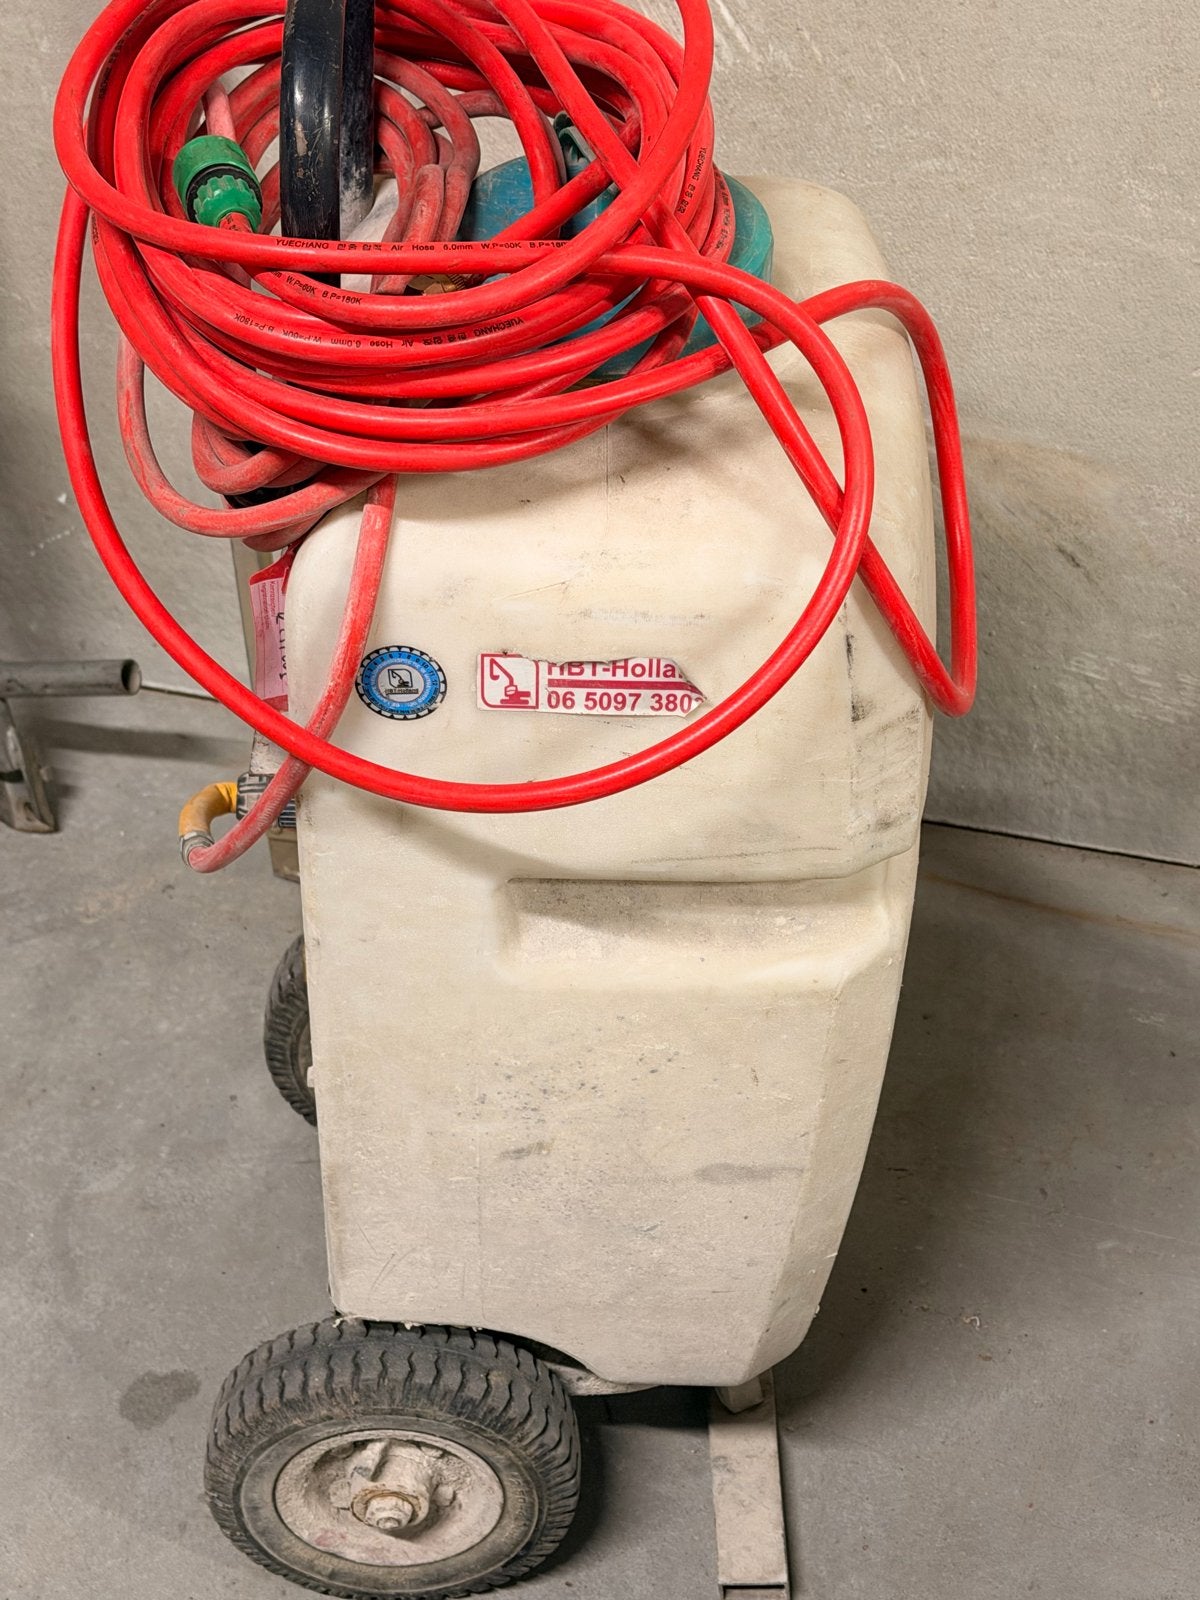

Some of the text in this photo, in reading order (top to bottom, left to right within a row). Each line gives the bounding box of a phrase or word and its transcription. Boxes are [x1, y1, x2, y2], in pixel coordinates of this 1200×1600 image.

[275, 238, 329, 250] YUECHANG
[390, 244, 404, 252] Air
[411, 244, 435, 252] Hose
[474, 316, 525, 337] YUECHANG
[330, 338, 362, 348] 6.0mm
[369, 340, 393, 349] Hose
[401, 339, 414, 348] Air
[547, 658, 684, 679] HBT-Holla
[547, 690, 576, 709] 06
[583, 691, 643, 712] 5097
